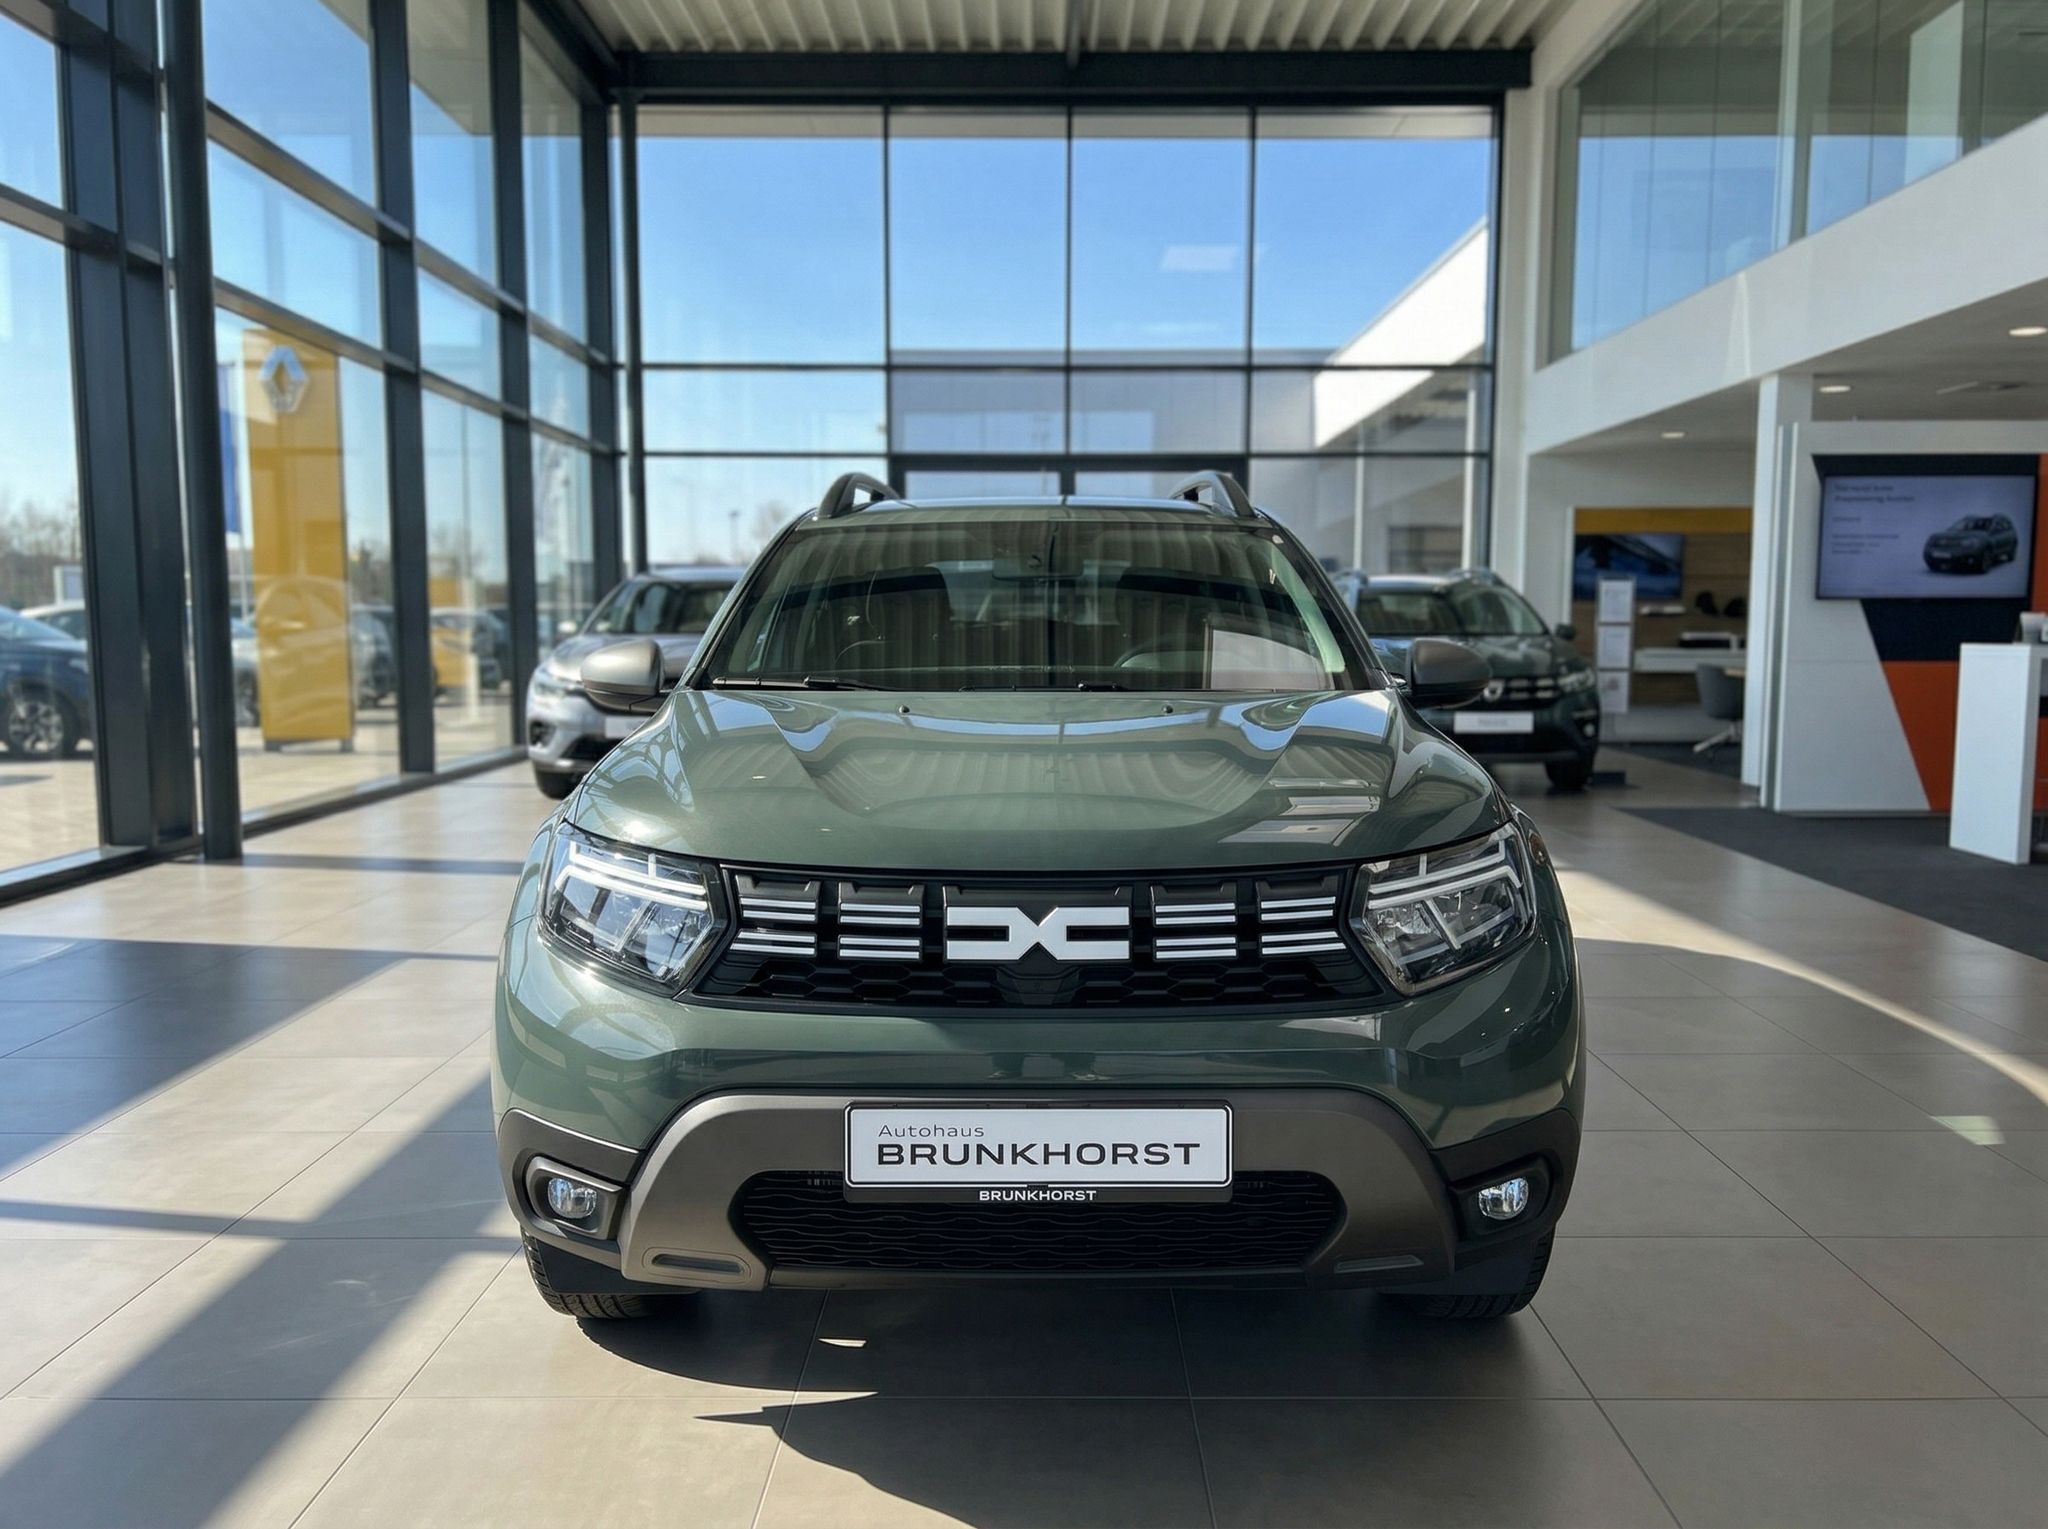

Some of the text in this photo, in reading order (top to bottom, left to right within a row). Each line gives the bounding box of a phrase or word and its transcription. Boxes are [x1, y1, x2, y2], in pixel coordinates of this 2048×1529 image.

[878, 1124, 985, 1138] Autohaus
[877, 1143, 1201, 1166] BRUNKHORST
[979, 1190, 1097, 1202] BRUNKHORST
